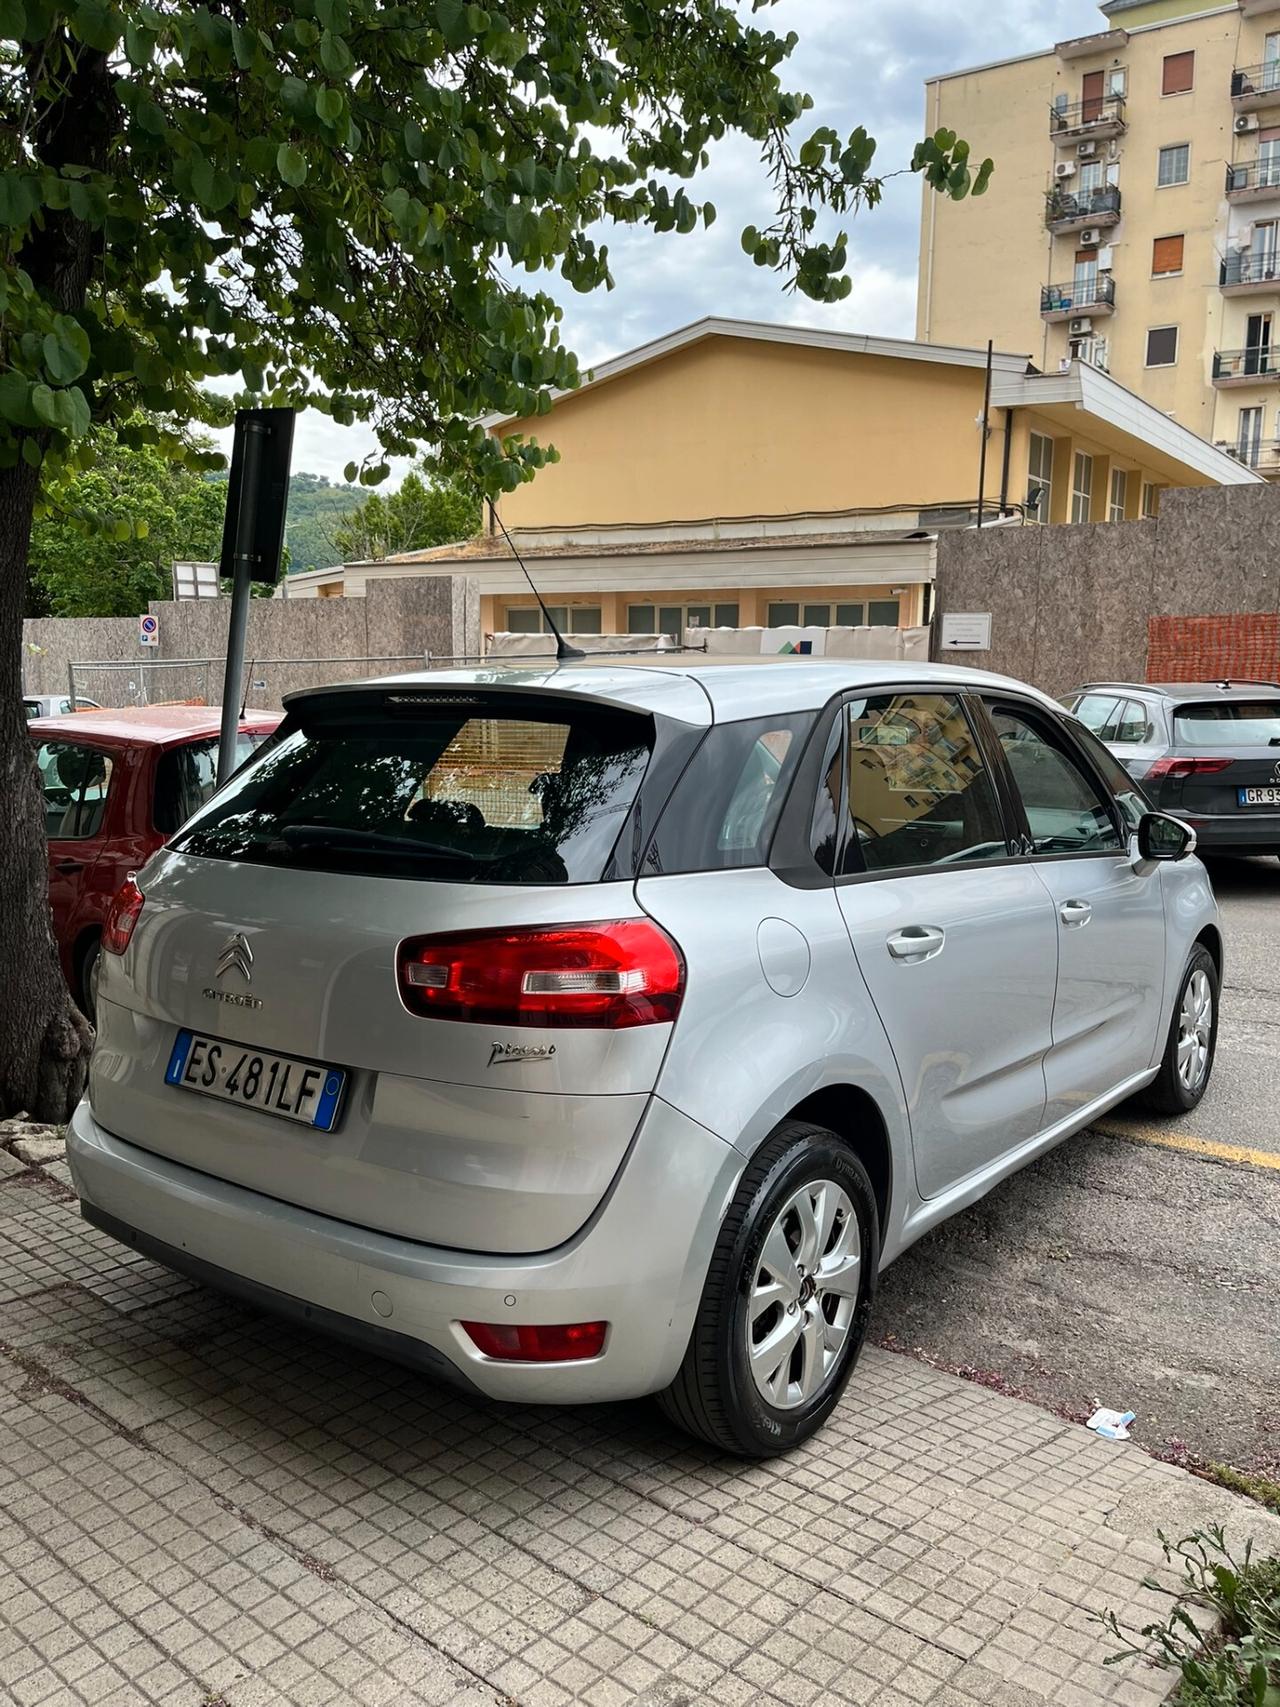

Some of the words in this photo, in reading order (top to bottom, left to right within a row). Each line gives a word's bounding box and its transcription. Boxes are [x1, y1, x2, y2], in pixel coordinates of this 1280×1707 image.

[1247, 789, 1263, 802] GR
[486, 1041, 556, 1068] Picasso
[184, 1040, 222, 1087] ES
[225, 1053, 321, 1114] 481LF
